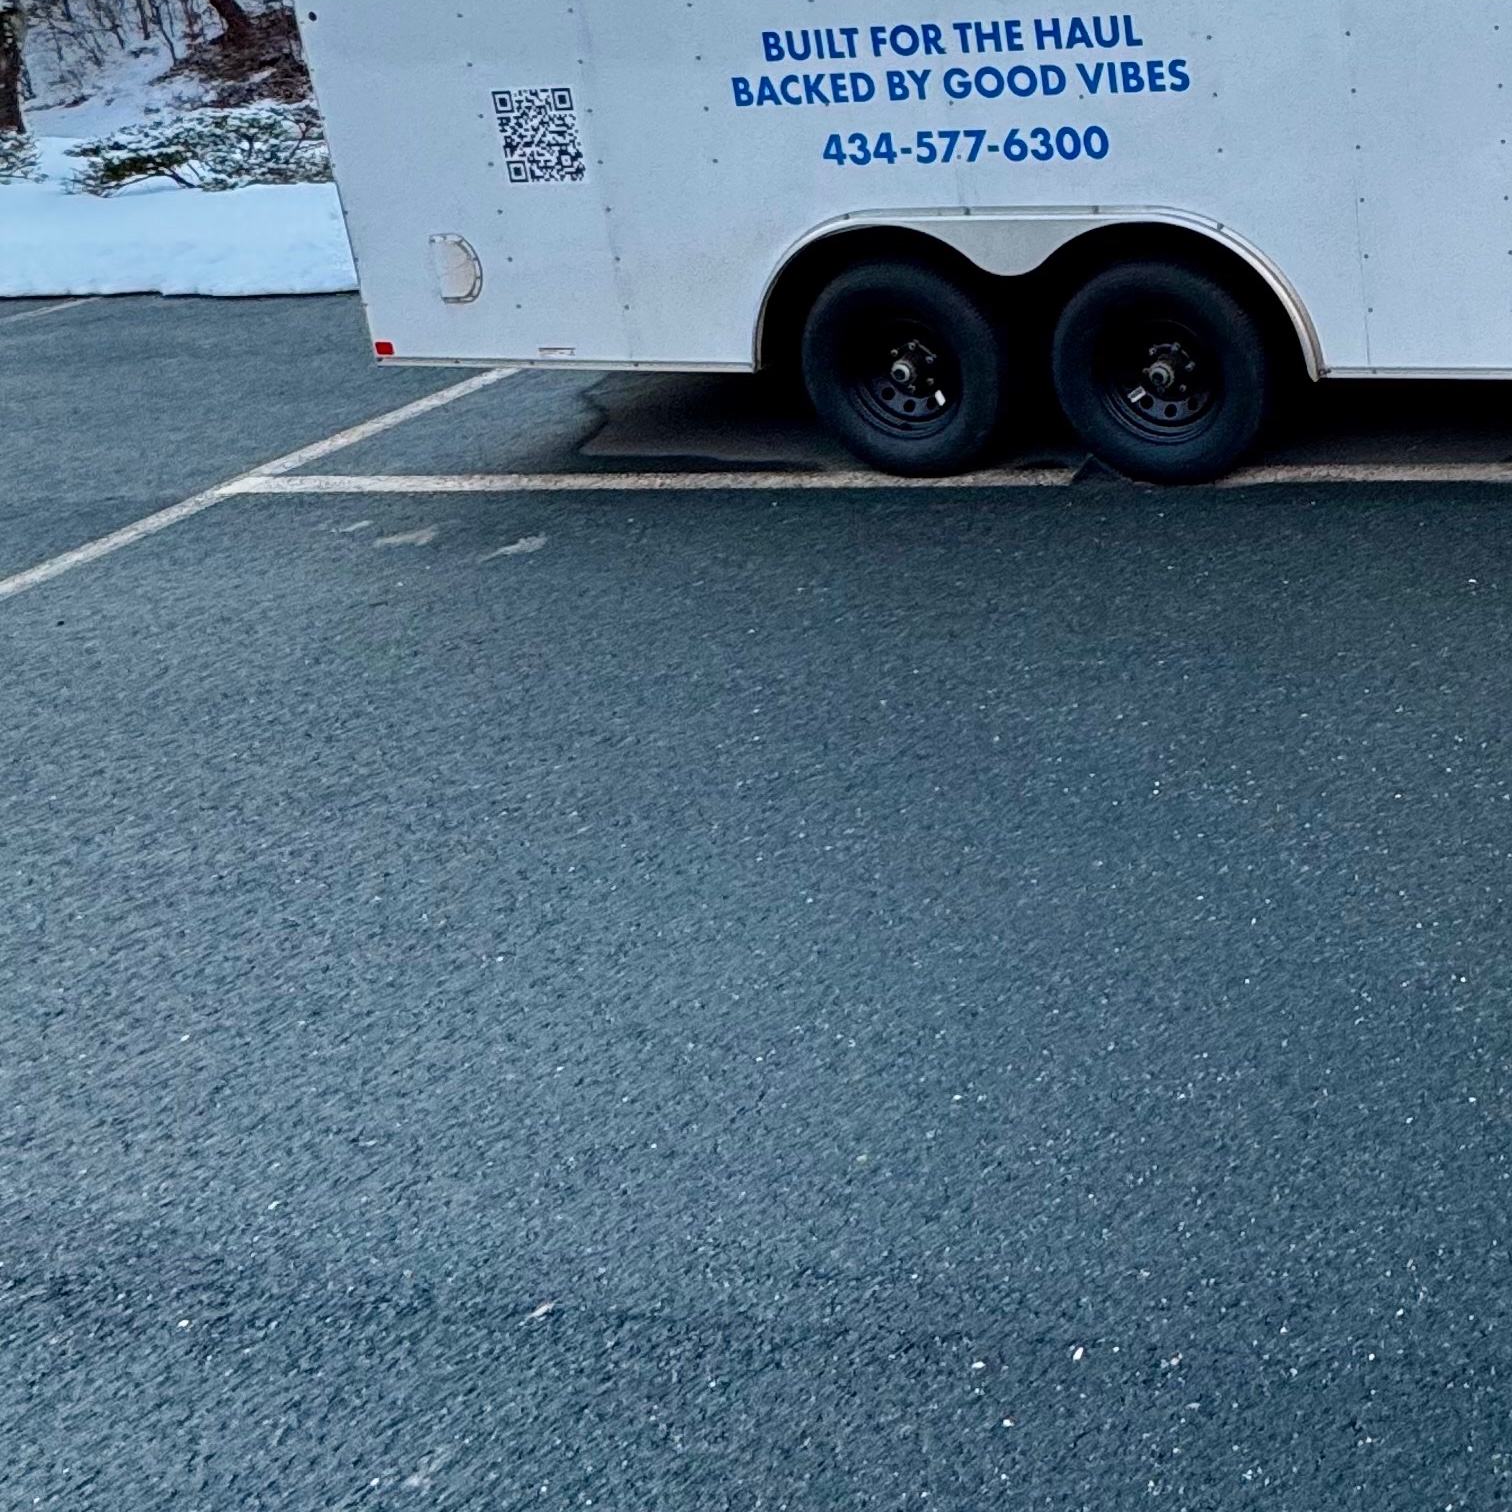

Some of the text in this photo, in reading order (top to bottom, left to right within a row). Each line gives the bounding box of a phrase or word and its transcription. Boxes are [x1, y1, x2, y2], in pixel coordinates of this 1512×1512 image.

[761, 14, 1144, 63] BUILT FOR THE HAUL
[730, 58, 1192, 108] BACKED BY GOOD VIBES
[822, 124, 1111, 167] 434-577-6300
